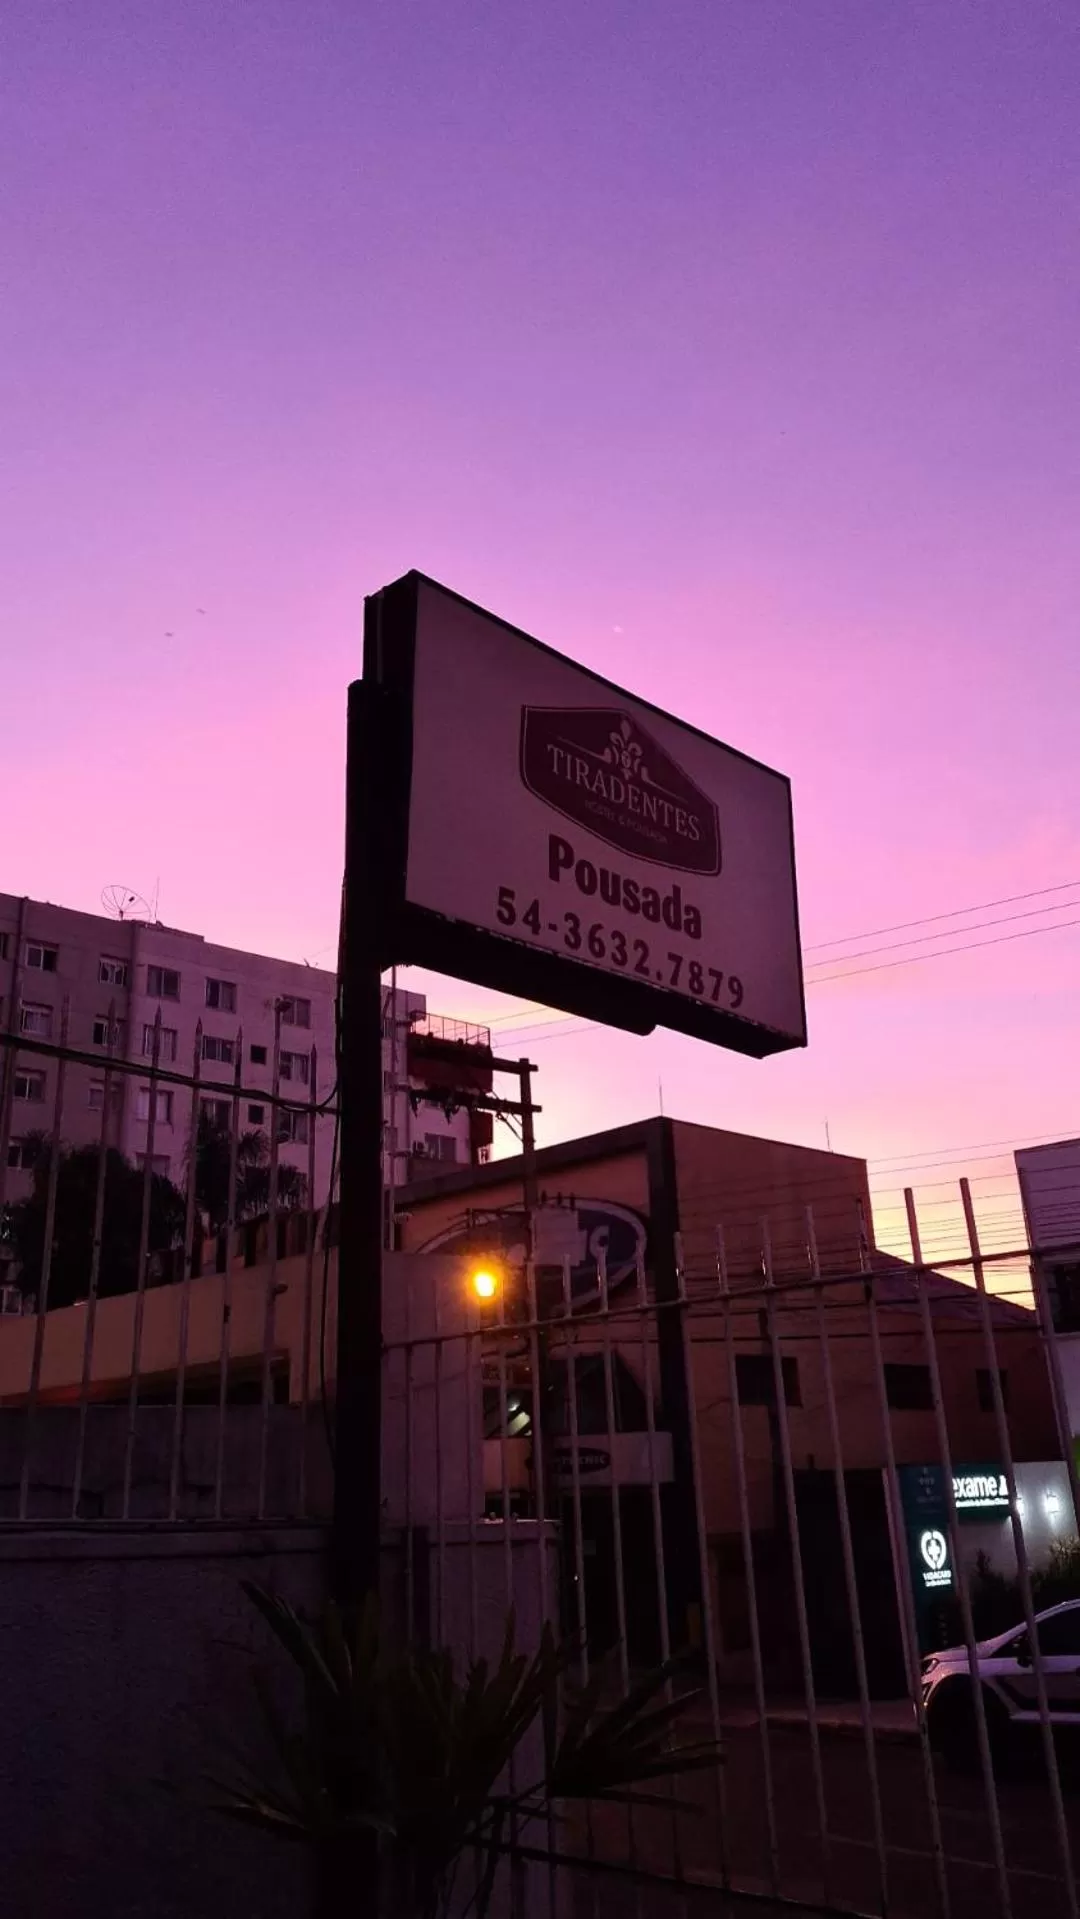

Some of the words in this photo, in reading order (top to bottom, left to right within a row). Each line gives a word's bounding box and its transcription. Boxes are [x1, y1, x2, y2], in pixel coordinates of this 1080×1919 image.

[547, 743, 701, 842] TIRADENTES
[548, 834, 702, 940] Pousada
[496, 886, 744, 1009] 54-3632.7879
